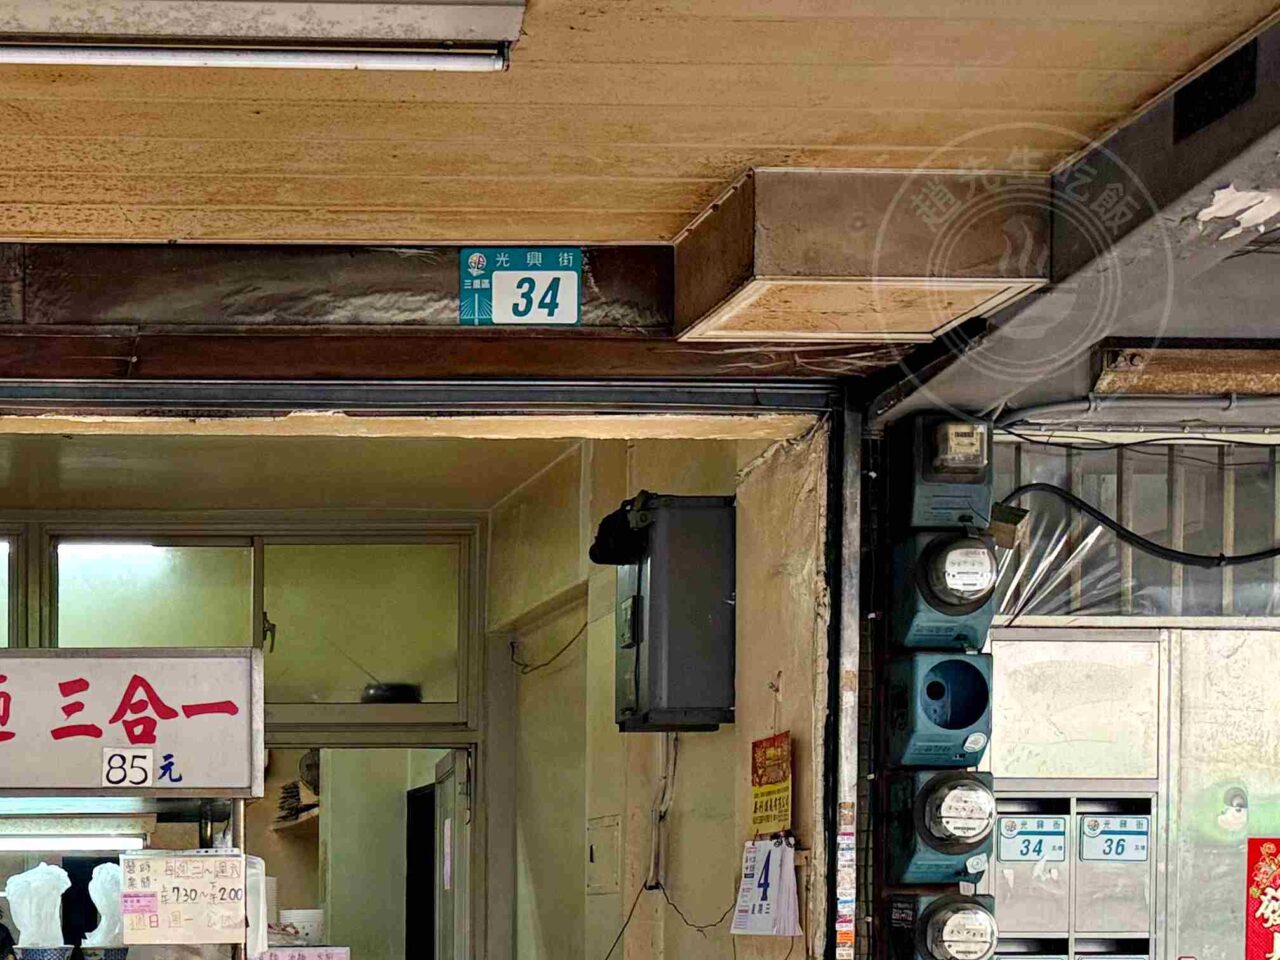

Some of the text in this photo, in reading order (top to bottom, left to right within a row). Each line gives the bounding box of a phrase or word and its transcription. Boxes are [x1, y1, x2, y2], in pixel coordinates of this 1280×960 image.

[496, 252, 573, 267] 光興街
[512, 277, 561, 317] 34
[50, 674, 238, 744] 三合一
[105, 753, 182, 785] 85元
[1020, 838, 1043, 856] 34
[1102, 838, 1126, 856] 36
[757, 849, 772, 901] 4
